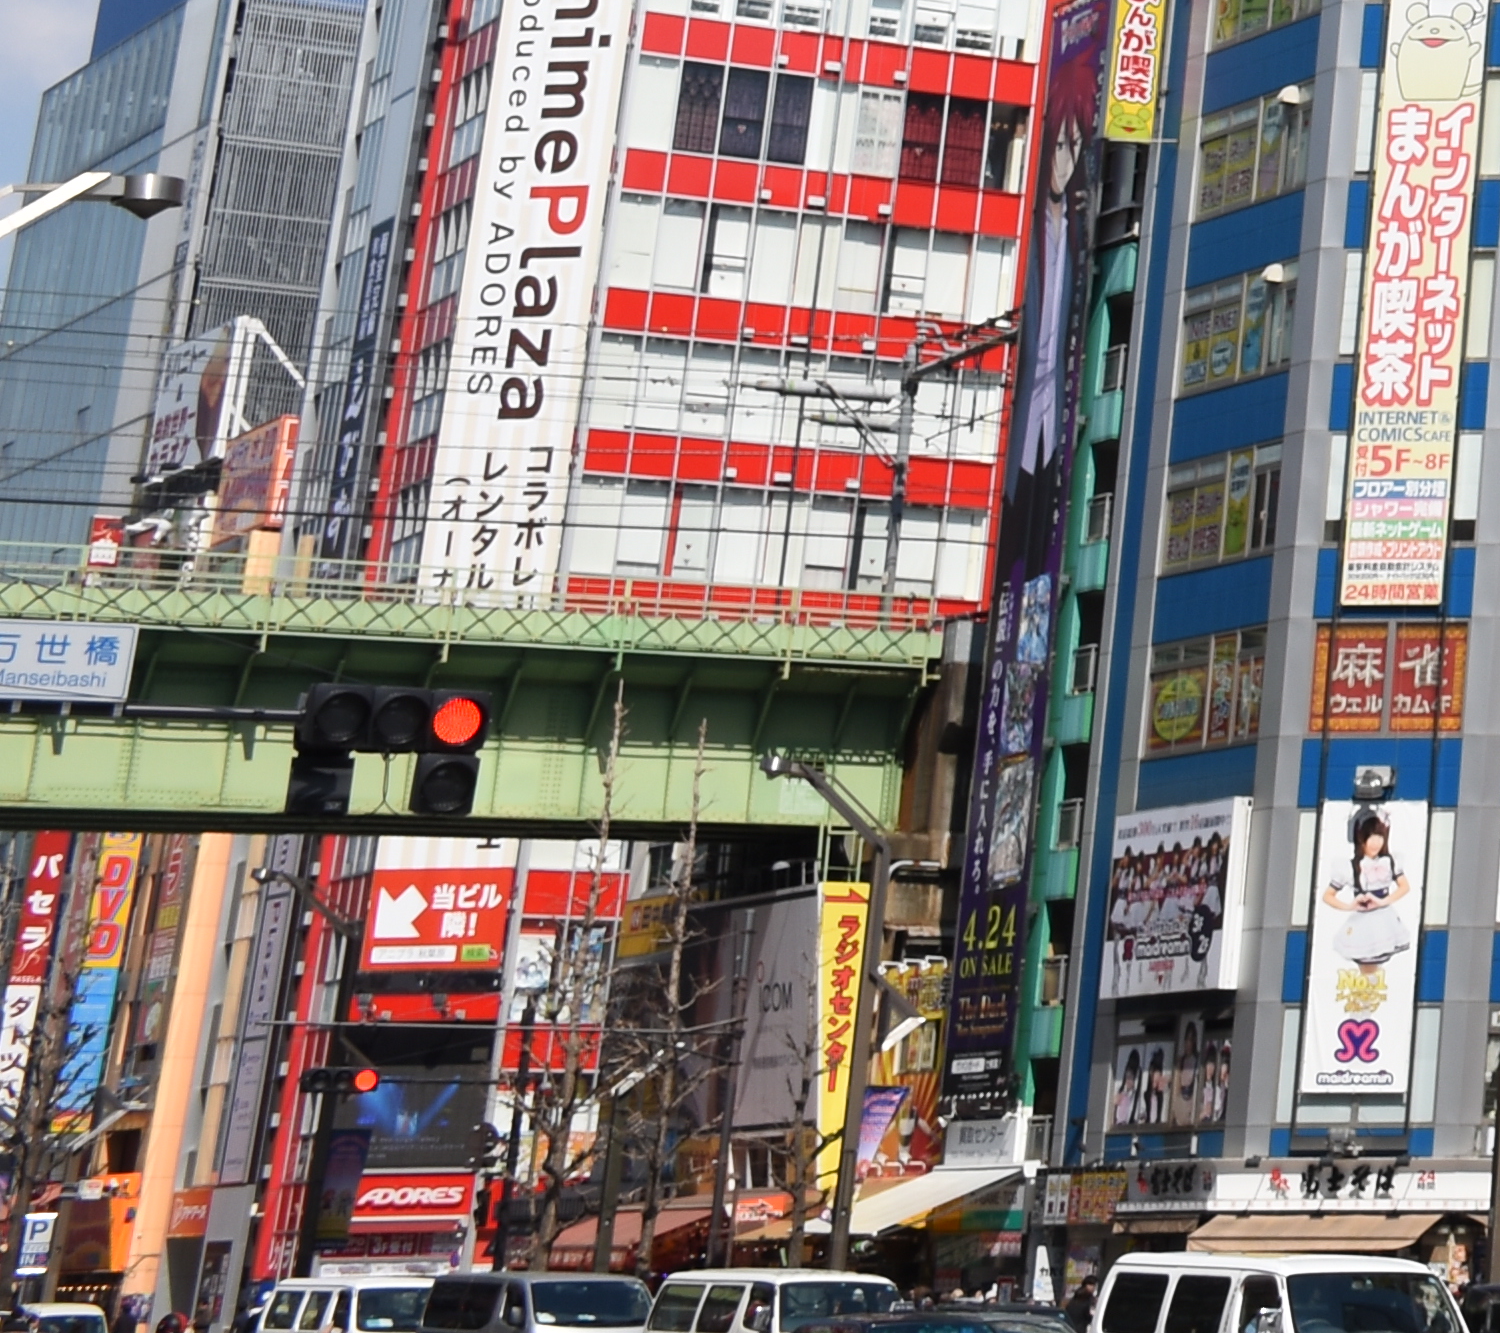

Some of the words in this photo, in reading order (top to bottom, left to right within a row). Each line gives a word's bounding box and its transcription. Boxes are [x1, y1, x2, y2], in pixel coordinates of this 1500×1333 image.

[493, 155, 526, 201] by
[1361, 103, 1433, 406] まんが喫茶
[1418, 102, 1474, 405] インターネット
[466, 221, 517, 396] ADORES
[1357, 427, 1423, 443] COMICS
[1358, 411, 1438, 426] INTERNET
[466, 450, 508, 591] レンタル
[1344, 584, 1439, 601] 24時間営業
[0, 633, 121, 668] 万世橋
[1332, 642, 1449, 689] 麻雀
[20, 852, 64, 953] パセラ
[85, 855, 132, 960] DVD
[431, 884, 502, 910] 当ビル
[962, 904, 1018, 953] 4.24
[958, 955, 979, 978] ON
[981, 953, 1013, 975] SALE
[1135, 937, 1191, 960] maidreamin
[1335, 969, 1388, 992] No.1
[824, 914, 861, 1093] ラジオセンター
[1315, 1070, 1394, 1086] maidreamin
[356, 1185, 466, 1209] ADORES
[1300, 1163, 1399, 1199] 富士そば
[28, 1218, 50, 1241] P
